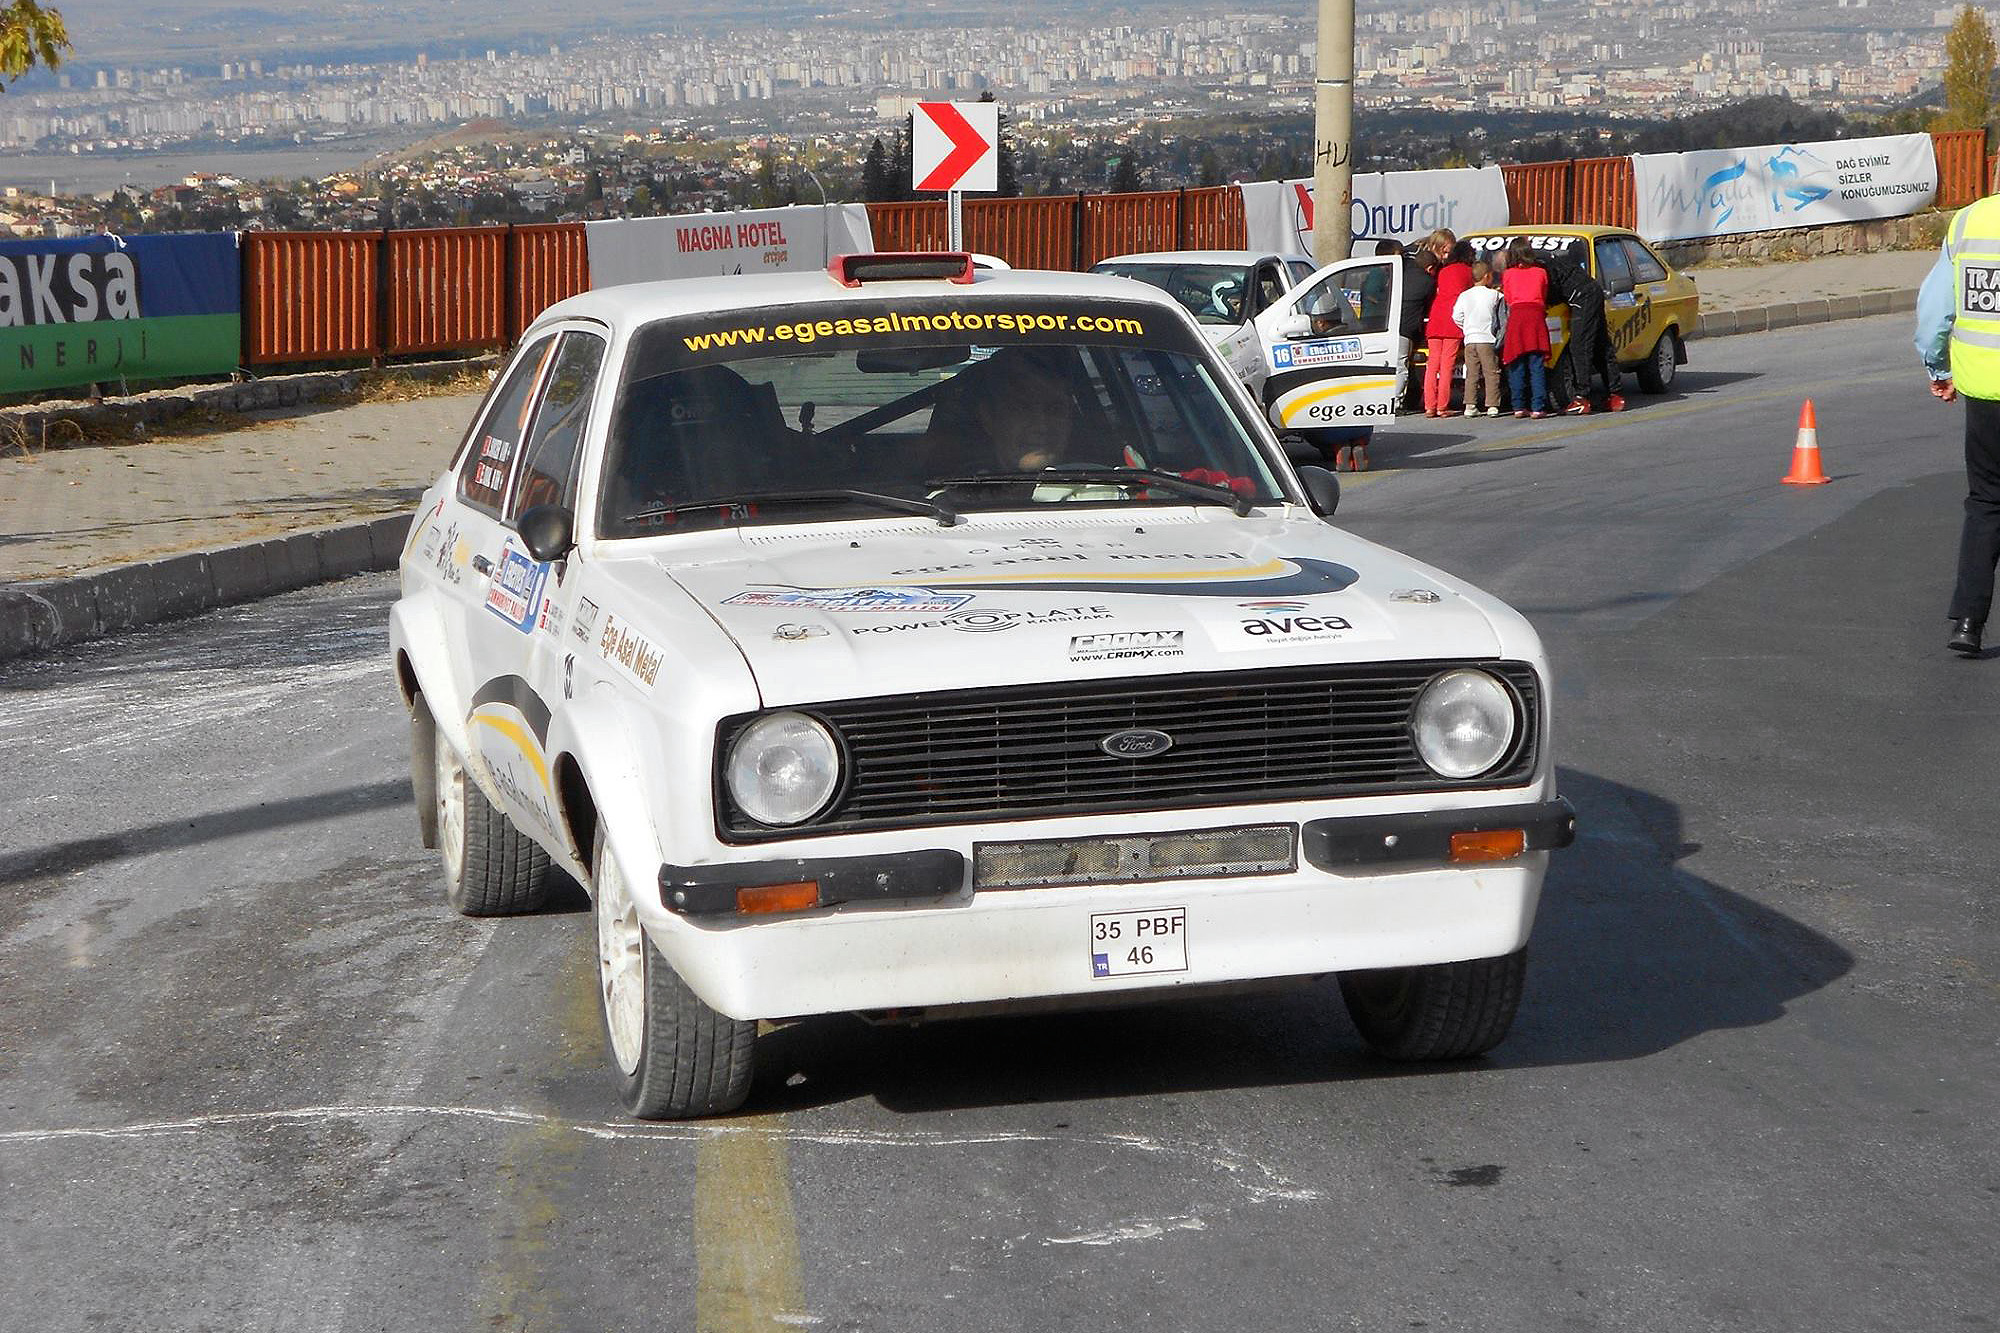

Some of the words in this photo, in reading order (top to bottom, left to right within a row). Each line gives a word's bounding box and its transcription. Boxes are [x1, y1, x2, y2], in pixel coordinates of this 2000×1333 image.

[1836, 159, 1856, 170] DAĞ
[1859, 154, 1891, 168] EVİMİZ
[1838, 172, 1872, 185] SİZLER
[1841, 182, 1929, 200] KONUĞUMUZSUNUZ
[676, 226, 733, 252] MAGNA
[737, 222, 787, 248] HOTEL
[1470, 236, 1575, 251] ROTEST
[683, 311, 1143, 351] www.egeasalmotorspor.com
[1274, 348, 1290, 364] 16
[1309, 403, 1346, 421] ege
[1353, 398, 1396, 415] asal
[852, 619, 960, 634] POWER
[1003, 604, 1112, 620] PLATE
[1240, 615, 1353, 636] avea
[1074, 631, 1183, 650] CROMX
[600, 614, 619, 659] Ege
[615, 626, 640, 668] Asal
[632, 639, 664, 687] Metal
[1070, 649, 1185, 662] www.CROMX.com
[1119, 735, 1156, 751] Ford
[1095, 921, 1121, 940] 35
[1136, 916, 1185, 937] PBF
[1127, 946, 1153, 965] 46
[1097, 963, 1108, 971] TR
